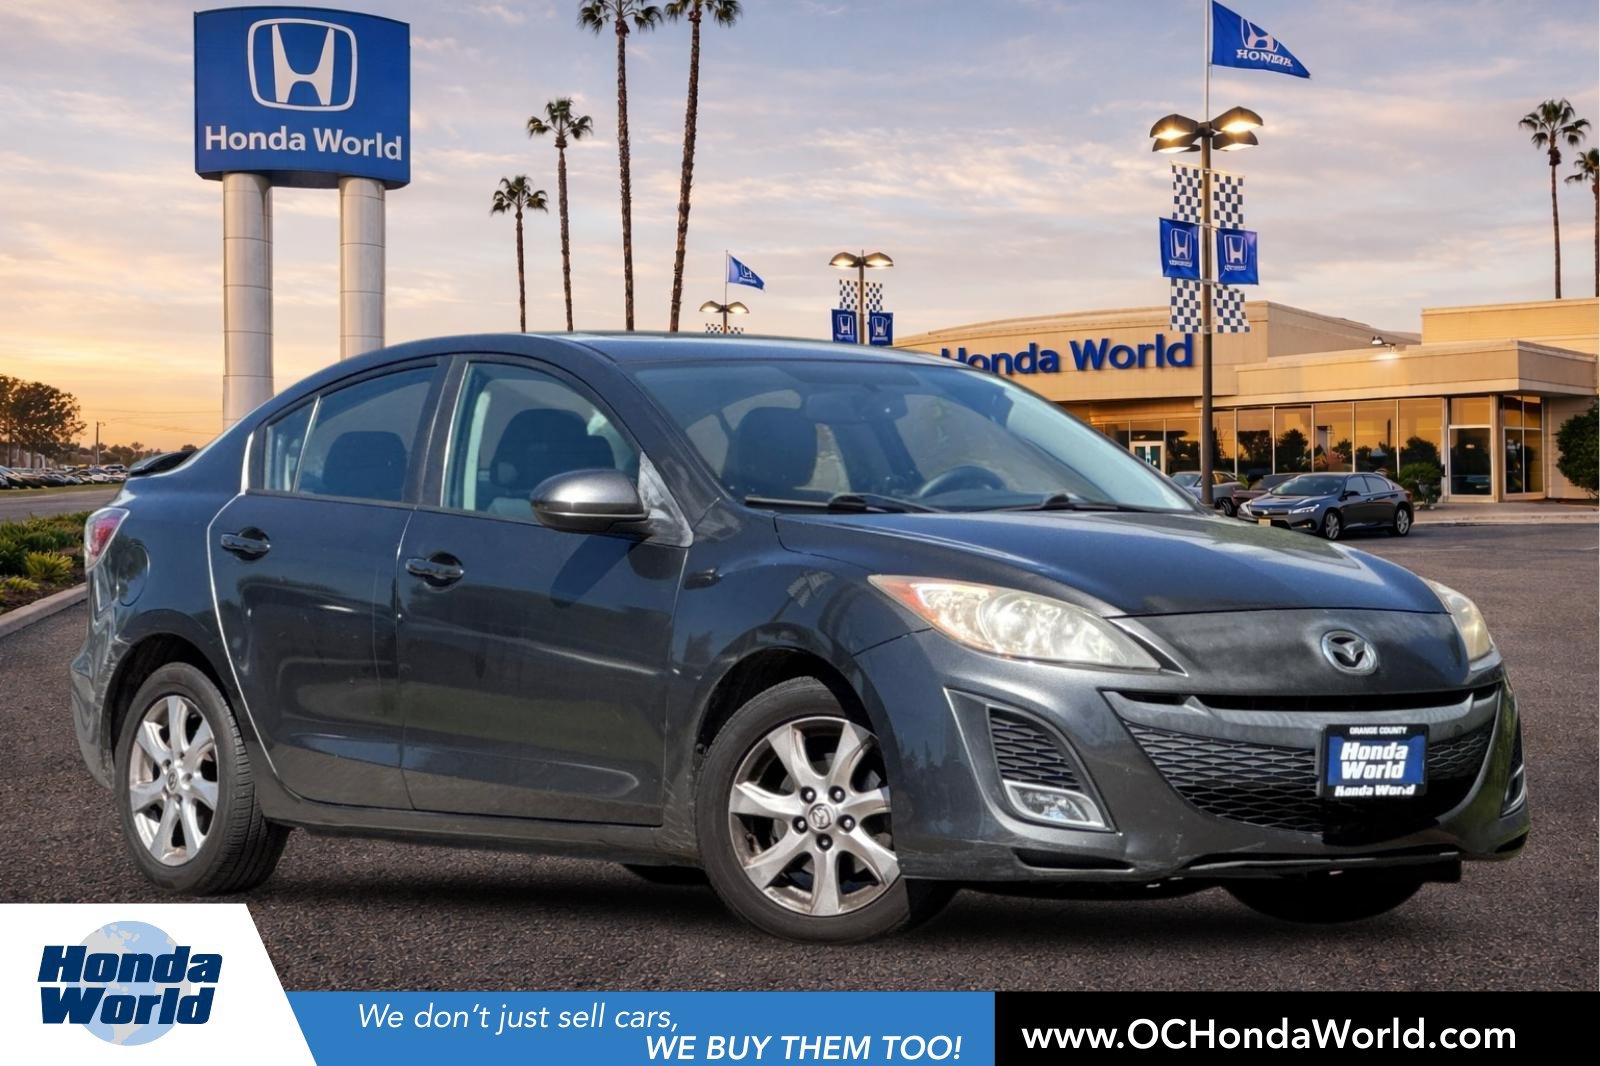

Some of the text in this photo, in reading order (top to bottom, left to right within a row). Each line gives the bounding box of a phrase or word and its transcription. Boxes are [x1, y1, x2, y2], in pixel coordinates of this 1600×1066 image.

[205, 125, 402, 160] Honda World
[1069, 333, 1194, 371] World
[1349, 727, 1378, 735] ORANGE
[1340, 742, 1409, 760] Honda
[1341, 761, 1406, 779] World
[1375, 784, 1416, 796] Word
